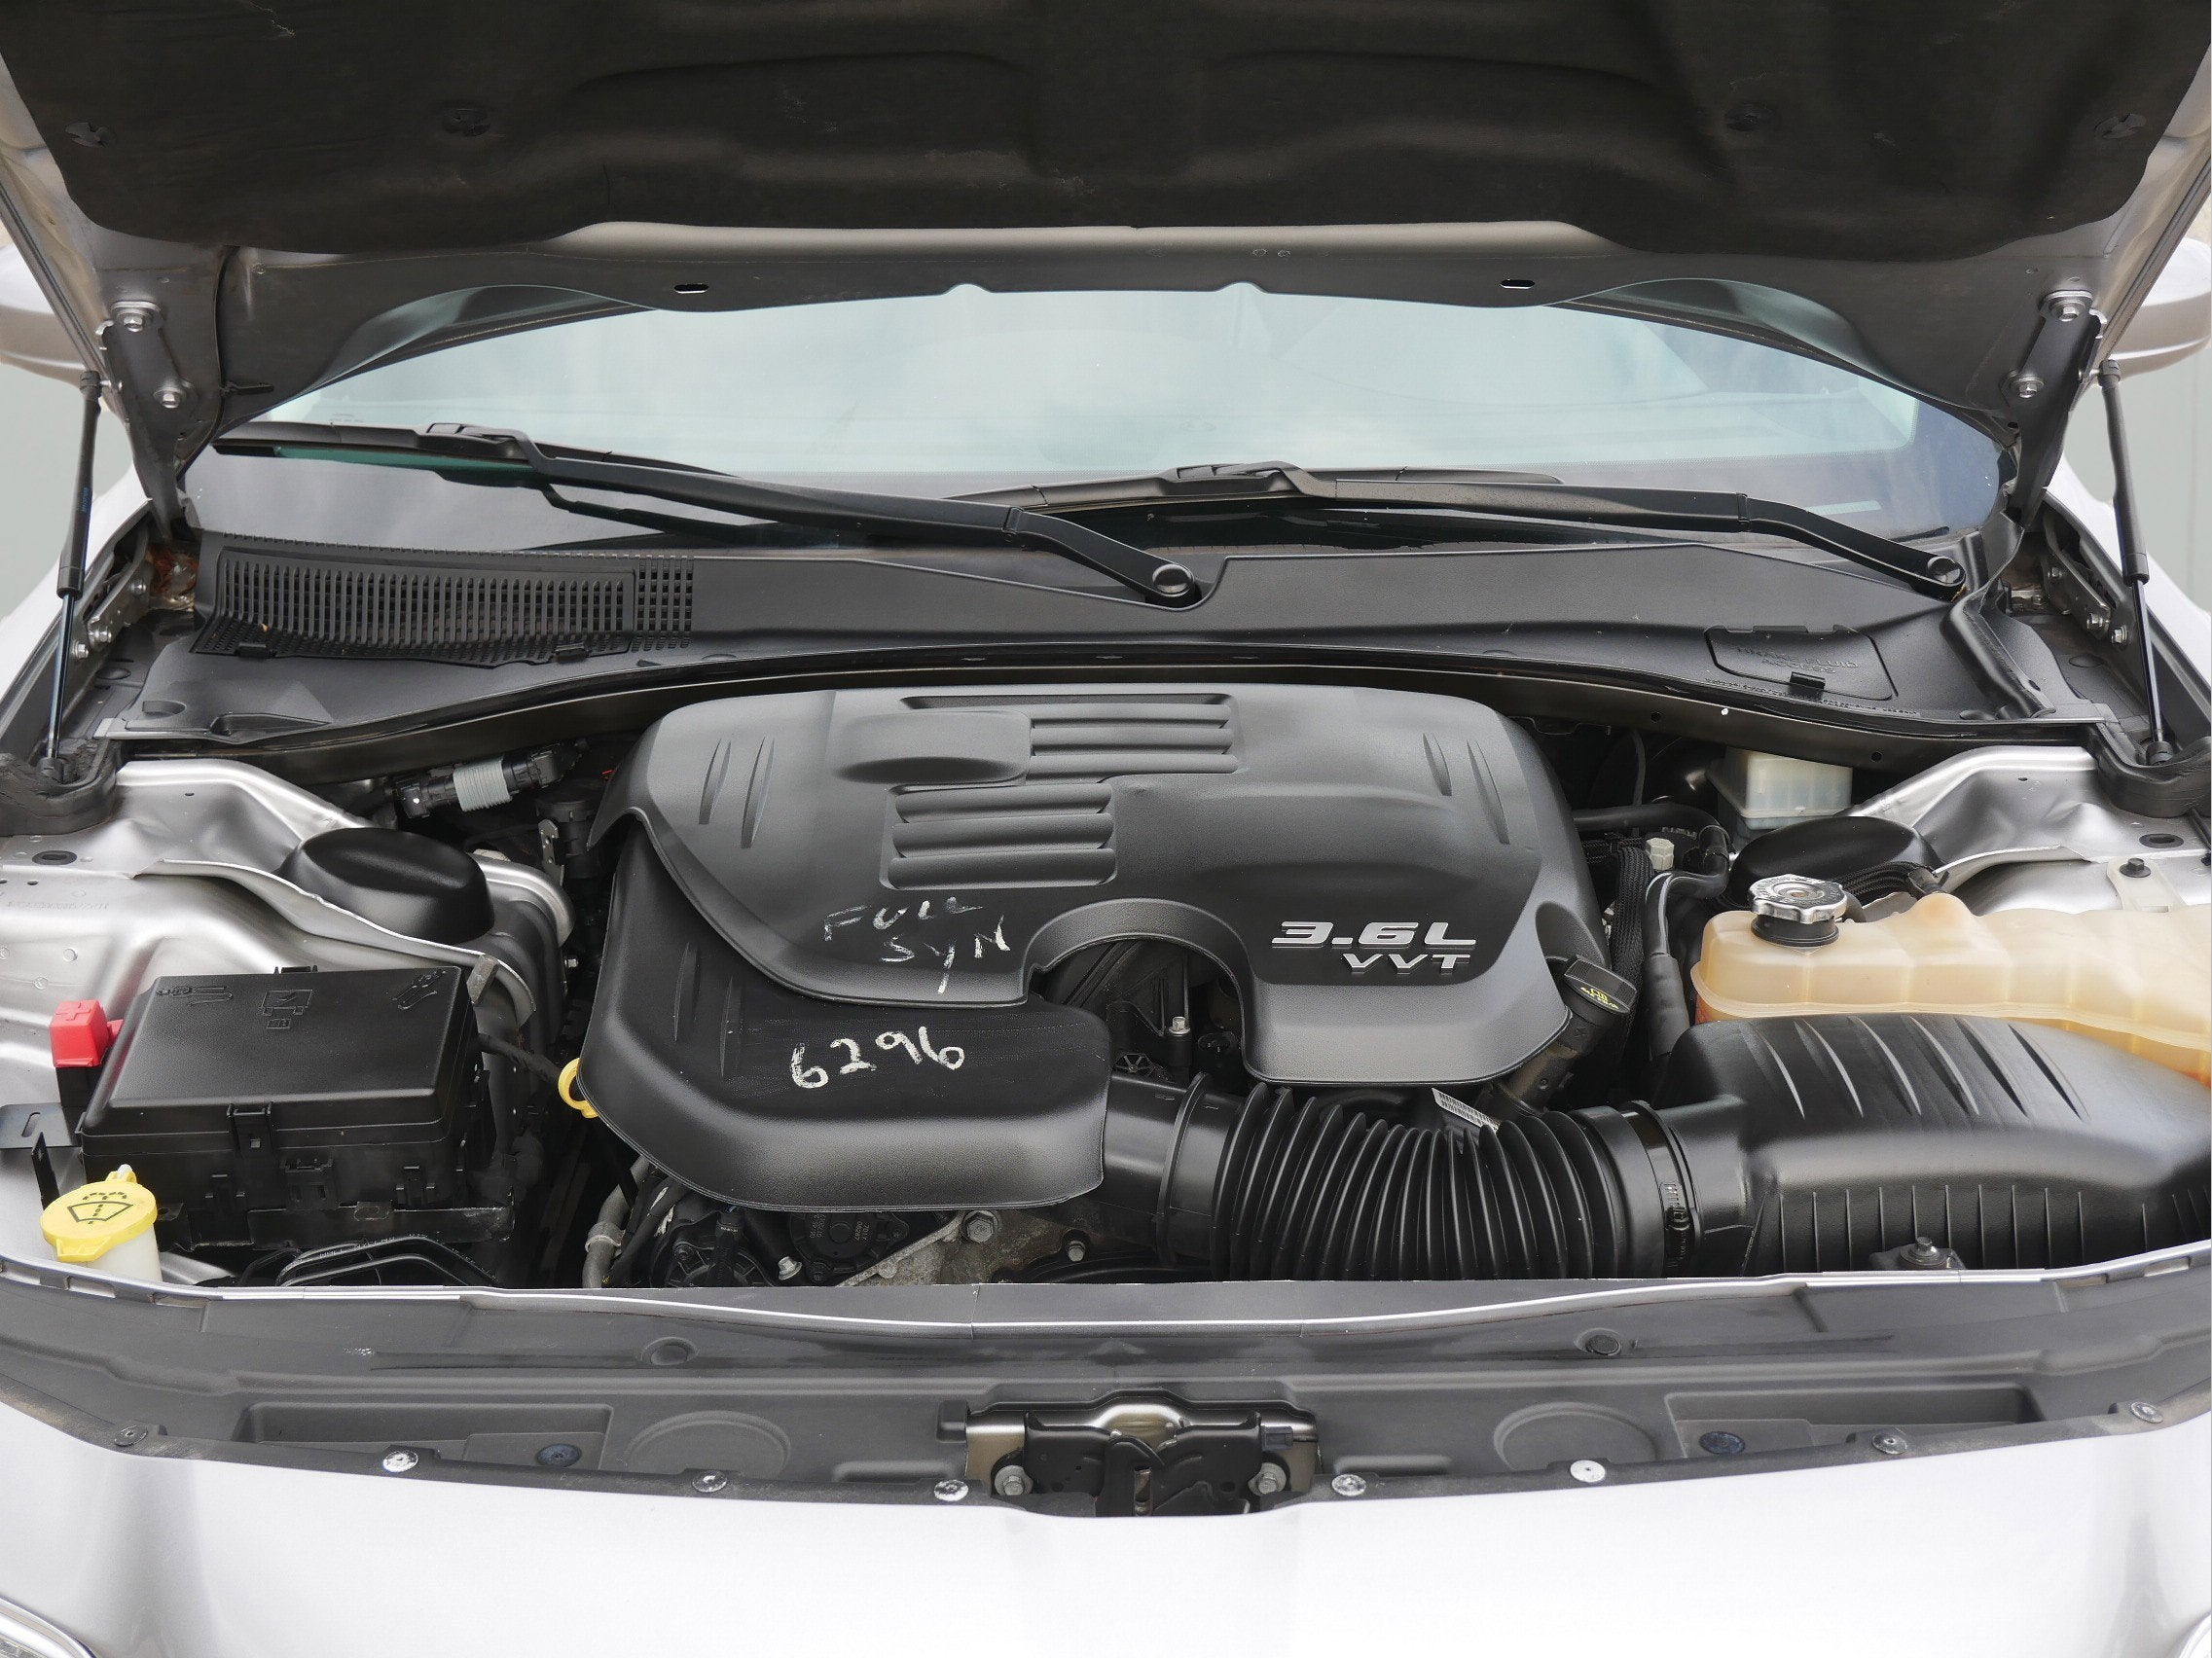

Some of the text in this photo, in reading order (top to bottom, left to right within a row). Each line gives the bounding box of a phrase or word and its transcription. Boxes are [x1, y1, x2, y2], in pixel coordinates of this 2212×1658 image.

[824, 896, 983, 942] FULL
[1271, 920, 1476, 948] 3.6L
[1342, 954, 1471, 973] VVT
[790, 1026, 965, 1089] 6296
